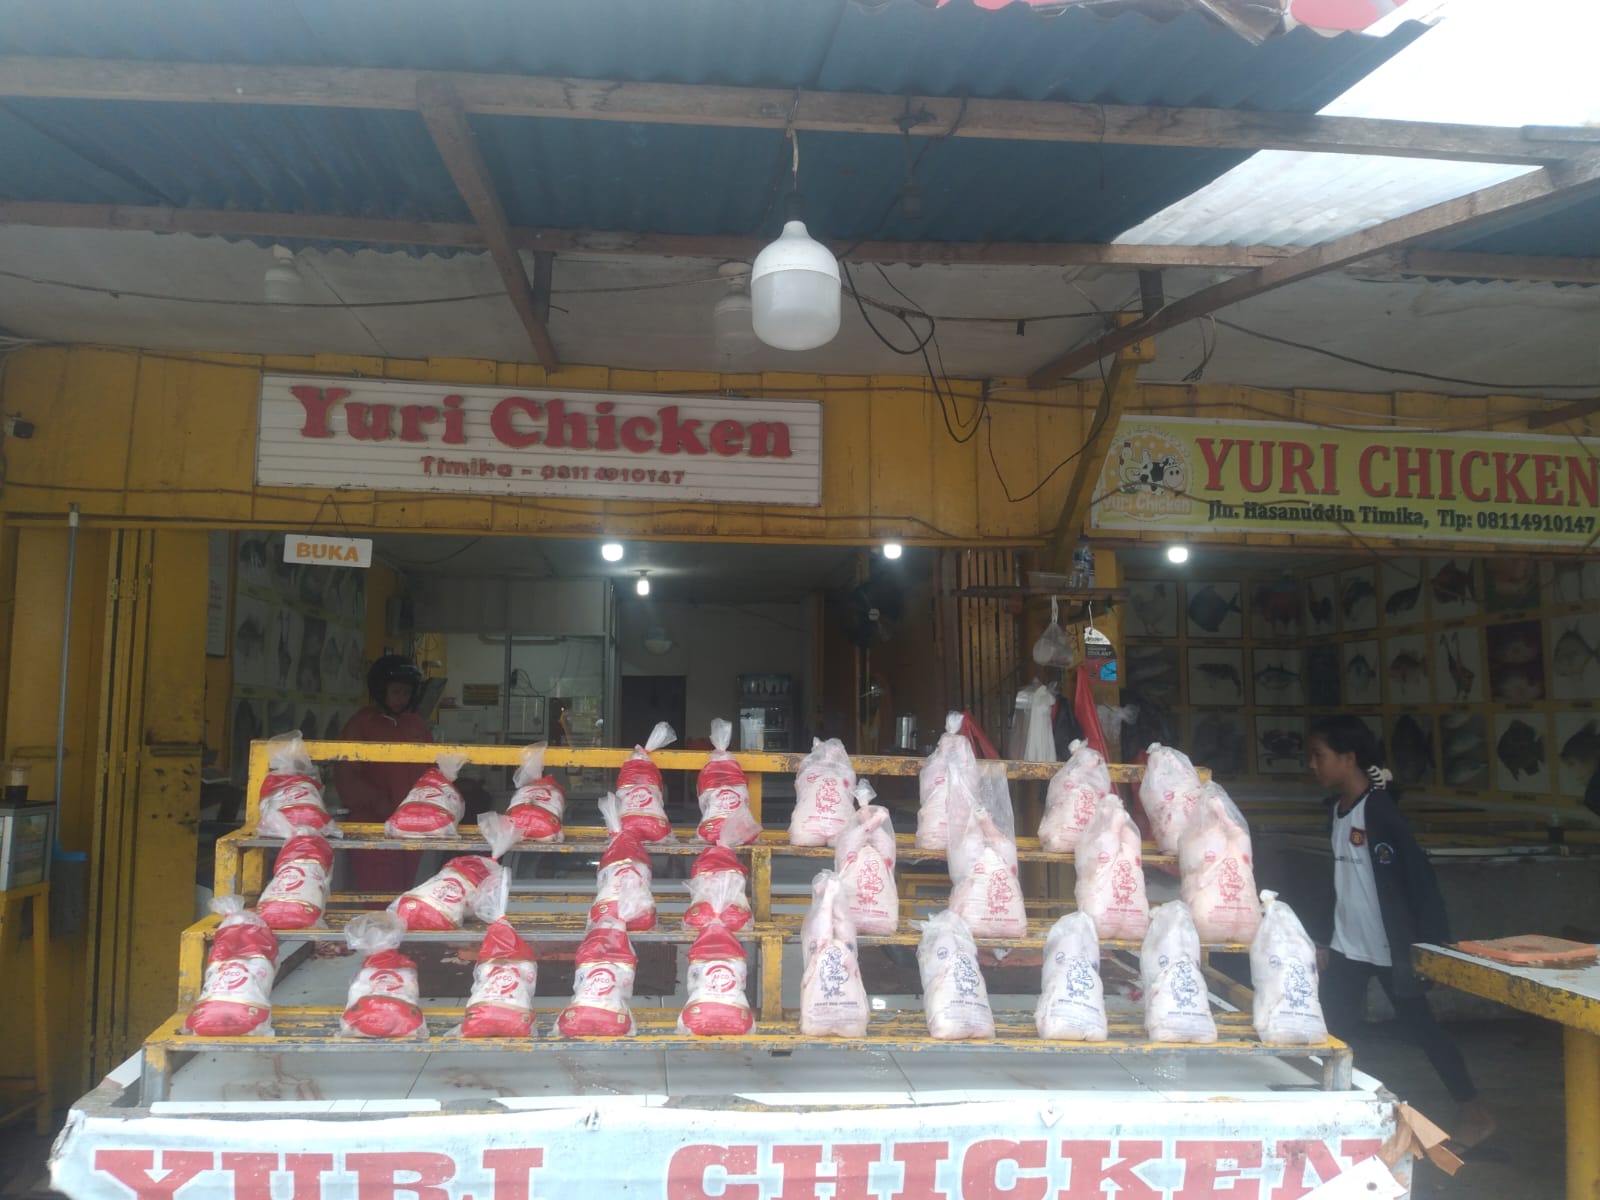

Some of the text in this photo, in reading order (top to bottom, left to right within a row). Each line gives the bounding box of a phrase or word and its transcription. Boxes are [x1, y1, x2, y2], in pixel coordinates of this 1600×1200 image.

[289, 385, 793, 458] Yuri Chicken
[1195, 437, 1339, 496] YURI
[1358, 444, 1600, 508] CHICKEN
[1208, 500, 1596, 535] Jln. Hasanuddin Timika, Tlp: 08114910147
[296, 541, 360, 563] BUKA
